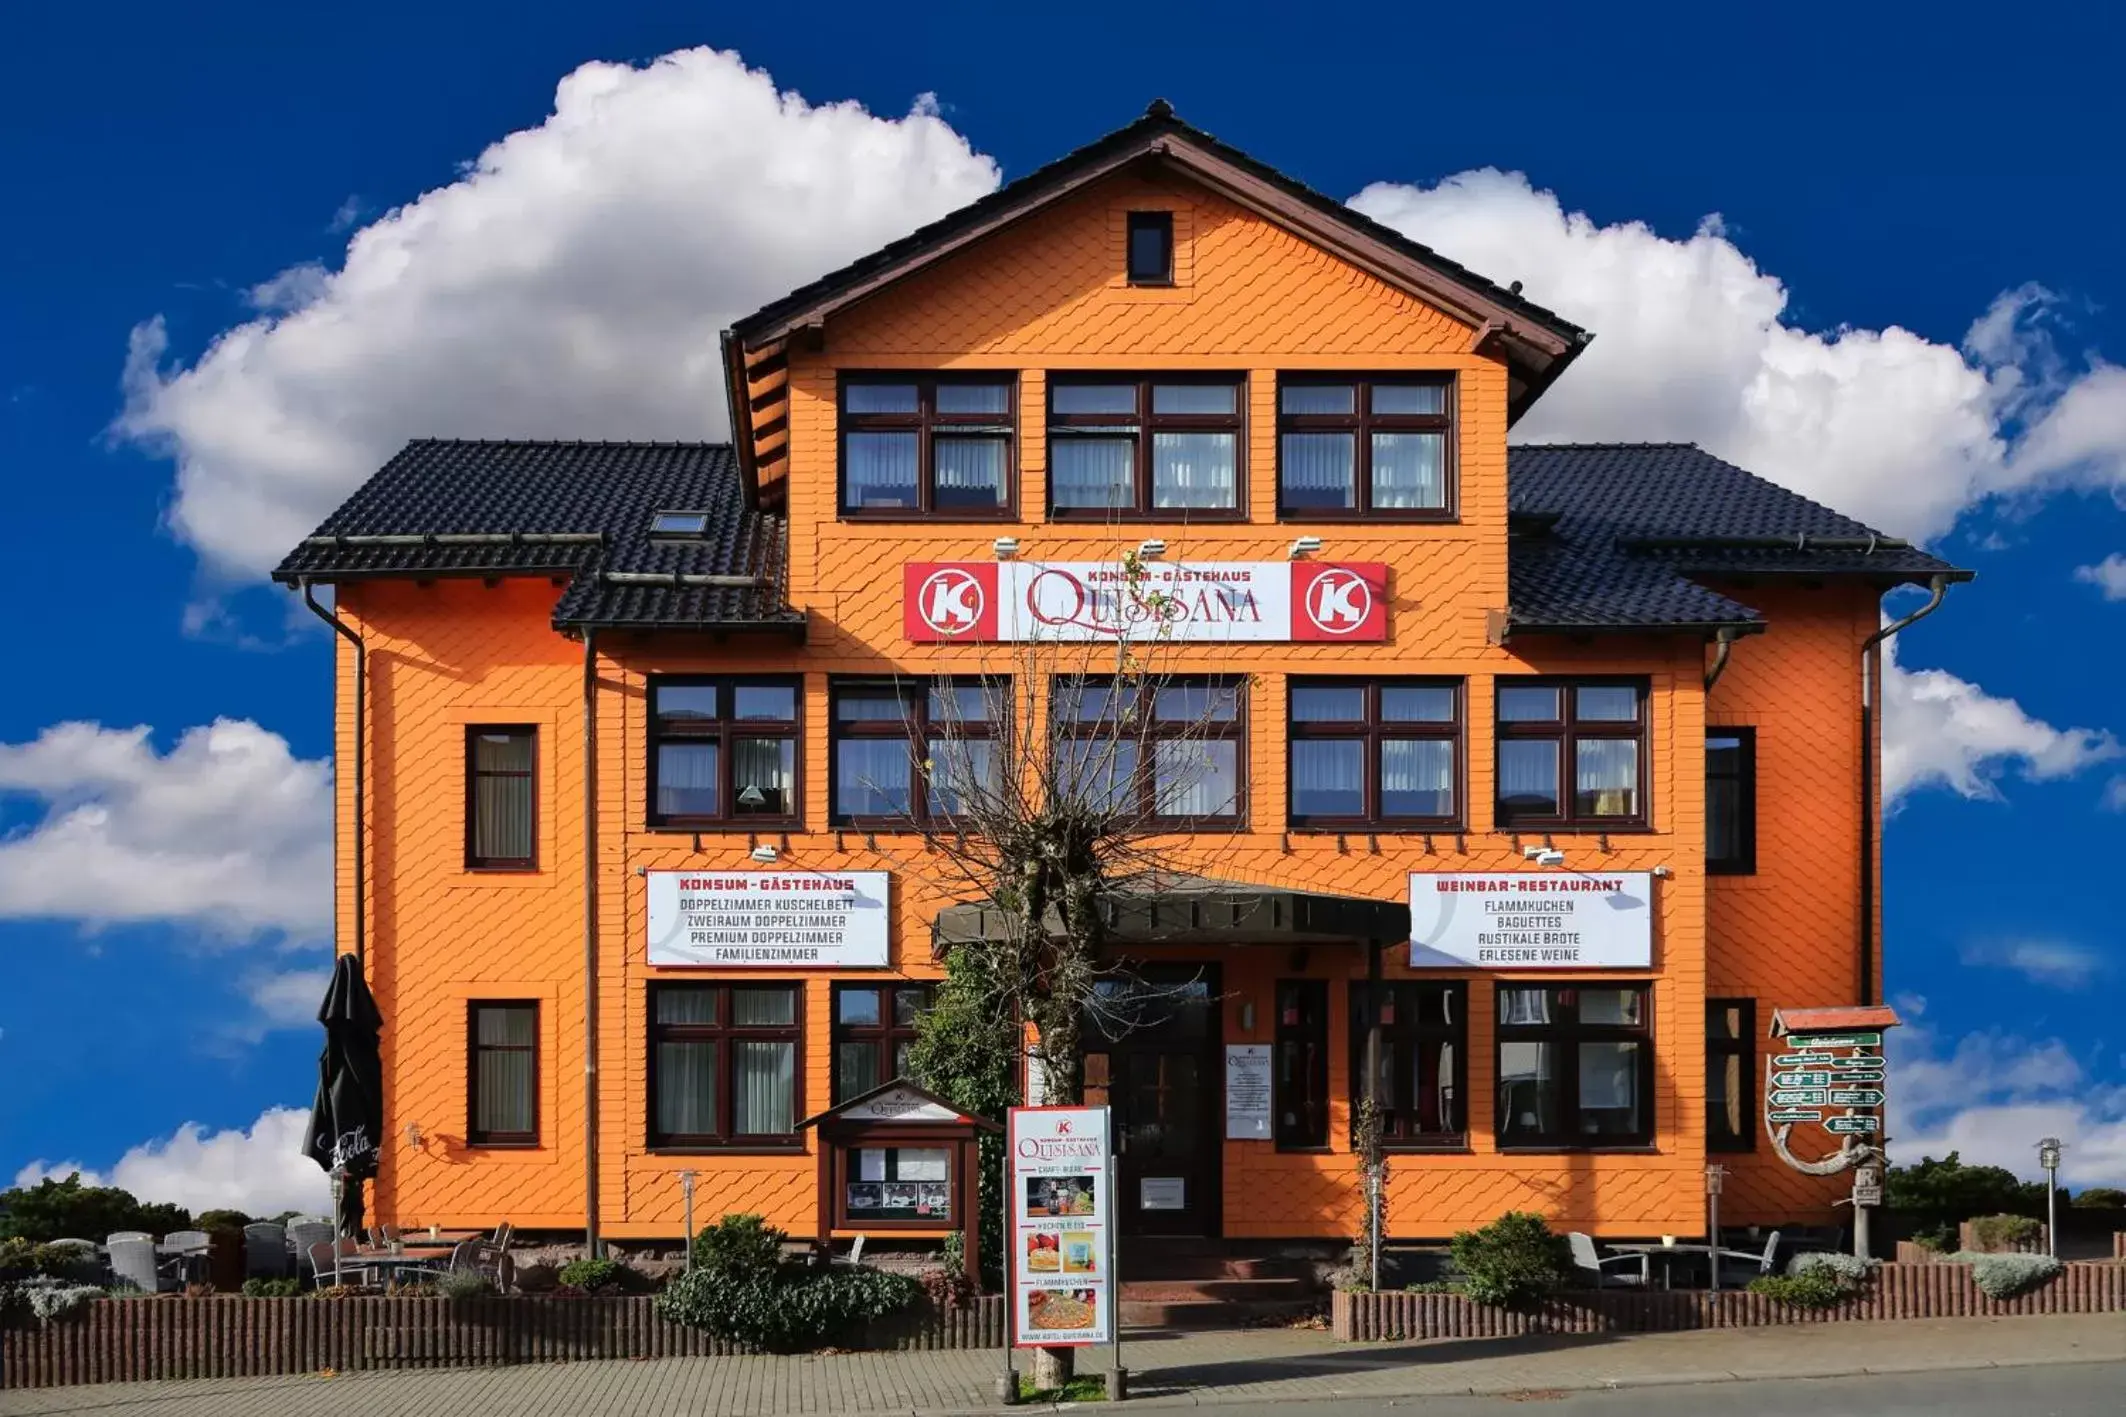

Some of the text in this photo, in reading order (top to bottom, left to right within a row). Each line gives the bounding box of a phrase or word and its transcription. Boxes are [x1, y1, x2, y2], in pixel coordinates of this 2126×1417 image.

[1027, 569, 1263, 634] QUISISANA
[1436, 880, 1624, 892] WEINBAR-RESTAURANT
[680, 899, 855, 911] DOPPELZIMMER KUSCHELBETT
[1484, 900, 1574, 912] FLAMMKUCHEN
[687, 915, 846, 927] ZWEIRAUM DOPPELZIMMER
[1497, 916, 1562, 928] BAGUETTES
[691, 932, 843, 944] PREMIUM DOPPELZIMMER
[1478, 933, 1580, 945] RUSTIKALE BROTE
[715, 948, 819, 960] FAMILIENZIMMER
[1479, 949, 1579, 961] ERLESENE WEINE
